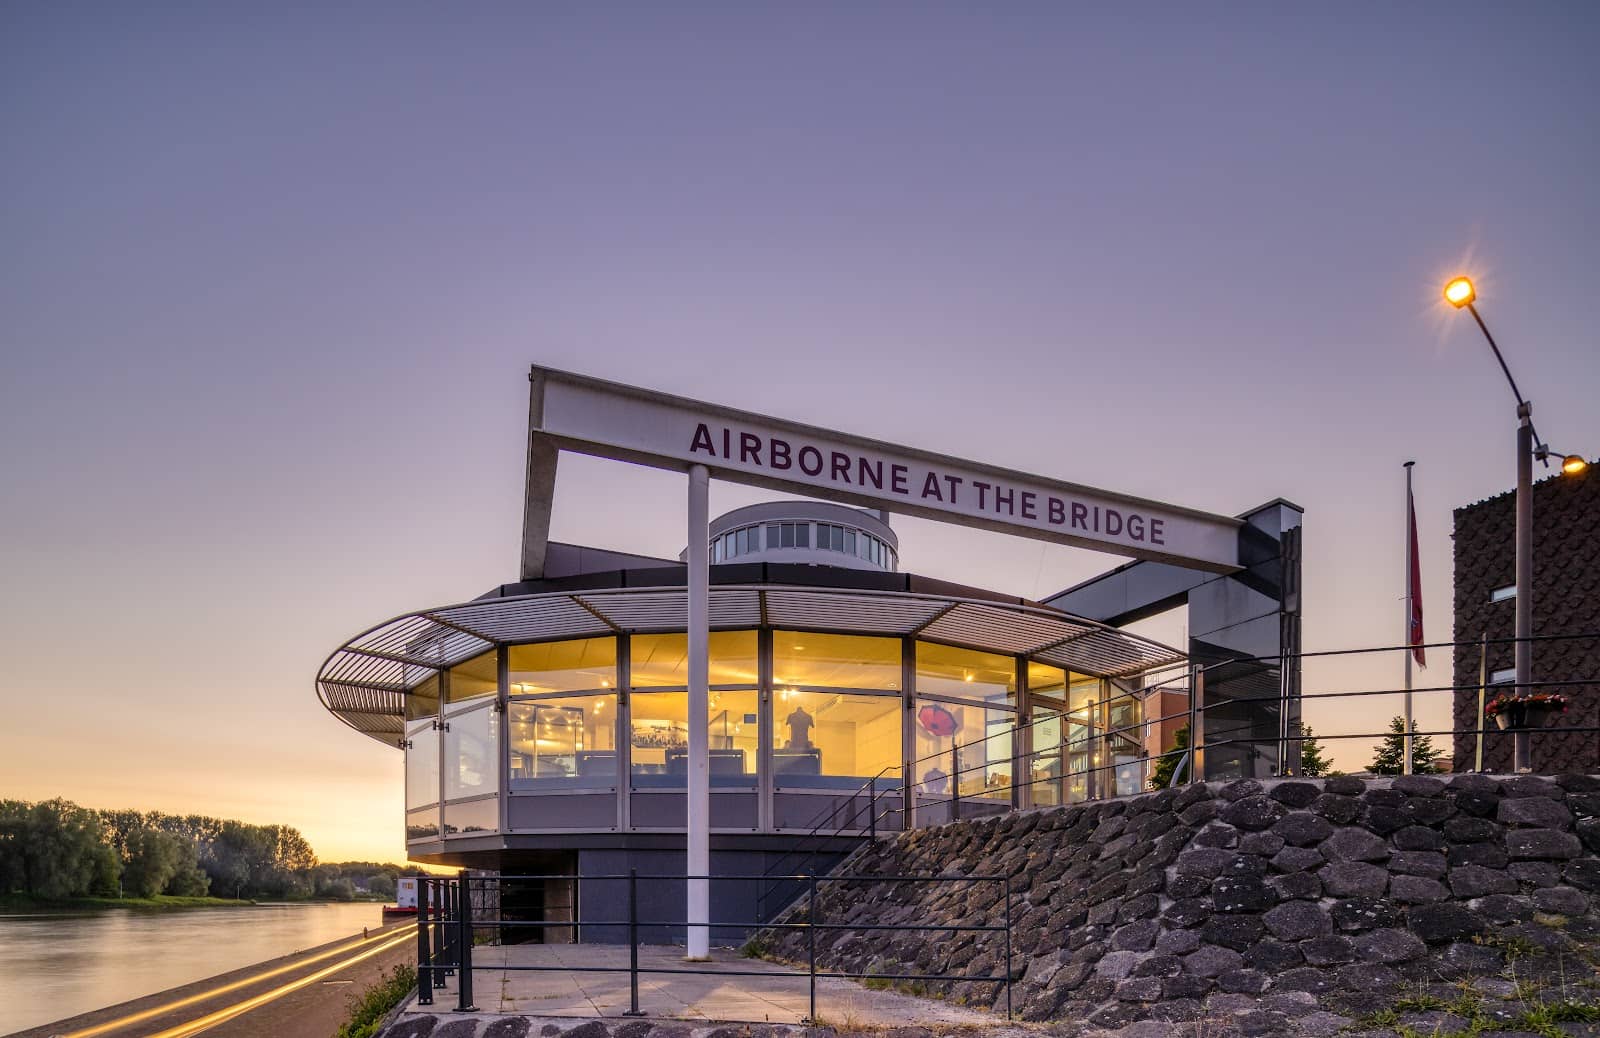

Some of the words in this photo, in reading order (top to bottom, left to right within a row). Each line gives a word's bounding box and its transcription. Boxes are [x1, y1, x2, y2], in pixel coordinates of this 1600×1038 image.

[688, 422, 910, 495] AIRBORNE
[920, 471, 964, 505] AT
[972, 480, 1038, 521] THE
[1048, 496, 1166, 546] BRIDGE
